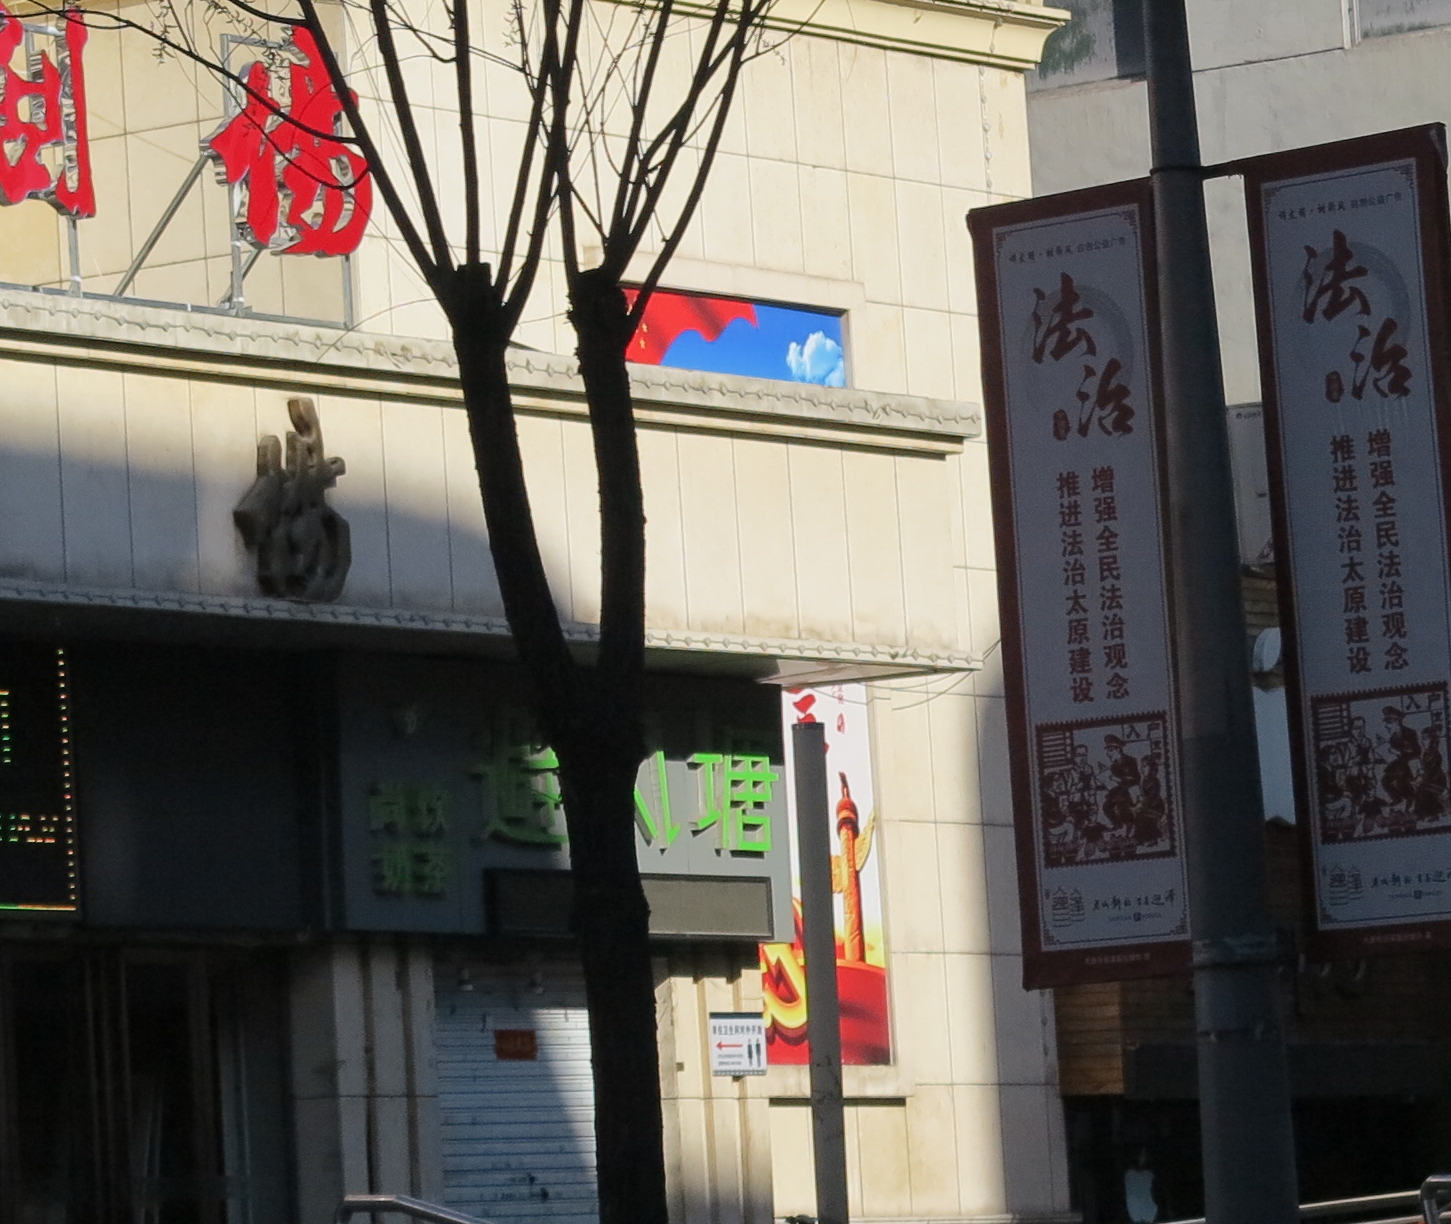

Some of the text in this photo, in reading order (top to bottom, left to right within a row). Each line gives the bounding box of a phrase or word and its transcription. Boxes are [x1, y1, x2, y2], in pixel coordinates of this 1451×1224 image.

[1032, 272, 1135, 440] 法治
[1302, 229, 1412, 401] 法治
[1056, 470, 1094, 704] 推进法治太原建设
[1091, 466, 1130, 700] 增强全民法治观念
[1330, 434, 1372, 675] 推进法治太原建设
[1367, 428, 1409, 671] 增强全民法治观念
